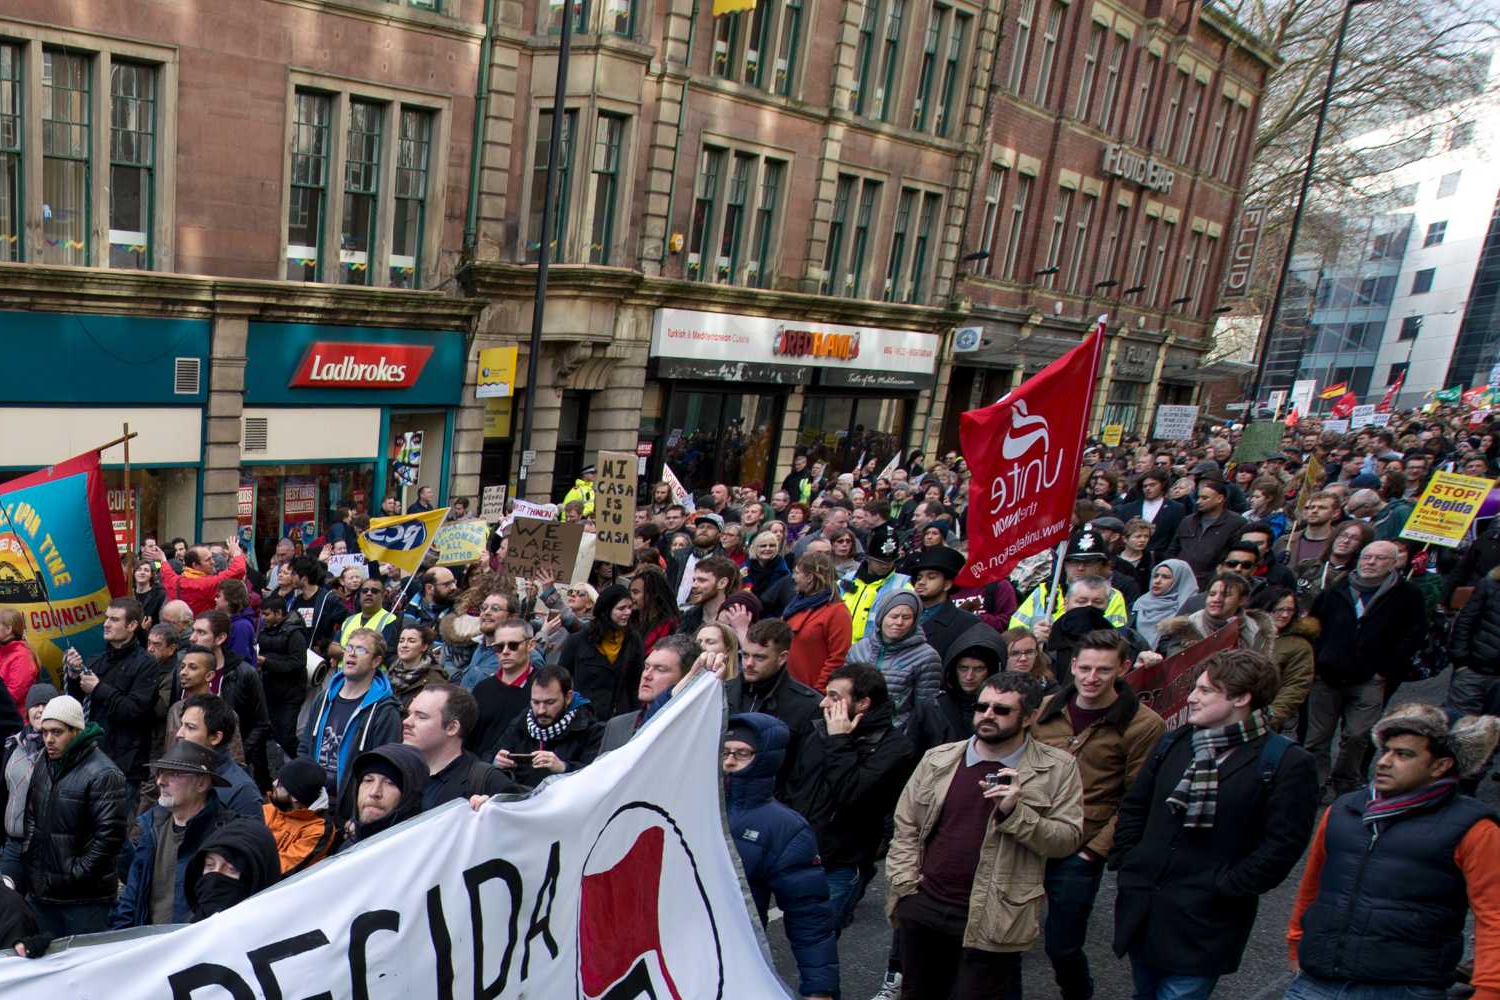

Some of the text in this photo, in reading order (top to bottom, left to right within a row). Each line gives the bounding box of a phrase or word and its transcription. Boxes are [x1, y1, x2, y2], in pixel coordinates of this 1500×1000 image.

[1228, 210, 1263, 289] FLUID
[308, 354, 407, 382] Ladbrokes
[602, 459, 628, 480] MI
[596, 483, 634, 497] CASA
[1431, 484, 1482, 501] STOP!
[606, 498, 622, 511] ES
[1423, 495, 1474, 515] Pegida
[601, 510, 622, 525] TU
[515, 522, 560, 540] WE
[597, 530, 630, 545] CASA
[526, 539, 560, 551] ARE
[39, 533, 73, 588] TYNE
[353, 554, 365, 564] NO
[508, 547, 560, 565] BLACK
[507, 564, 565, 582] WHE
[30, 600, 101, 630] COUNCIL
